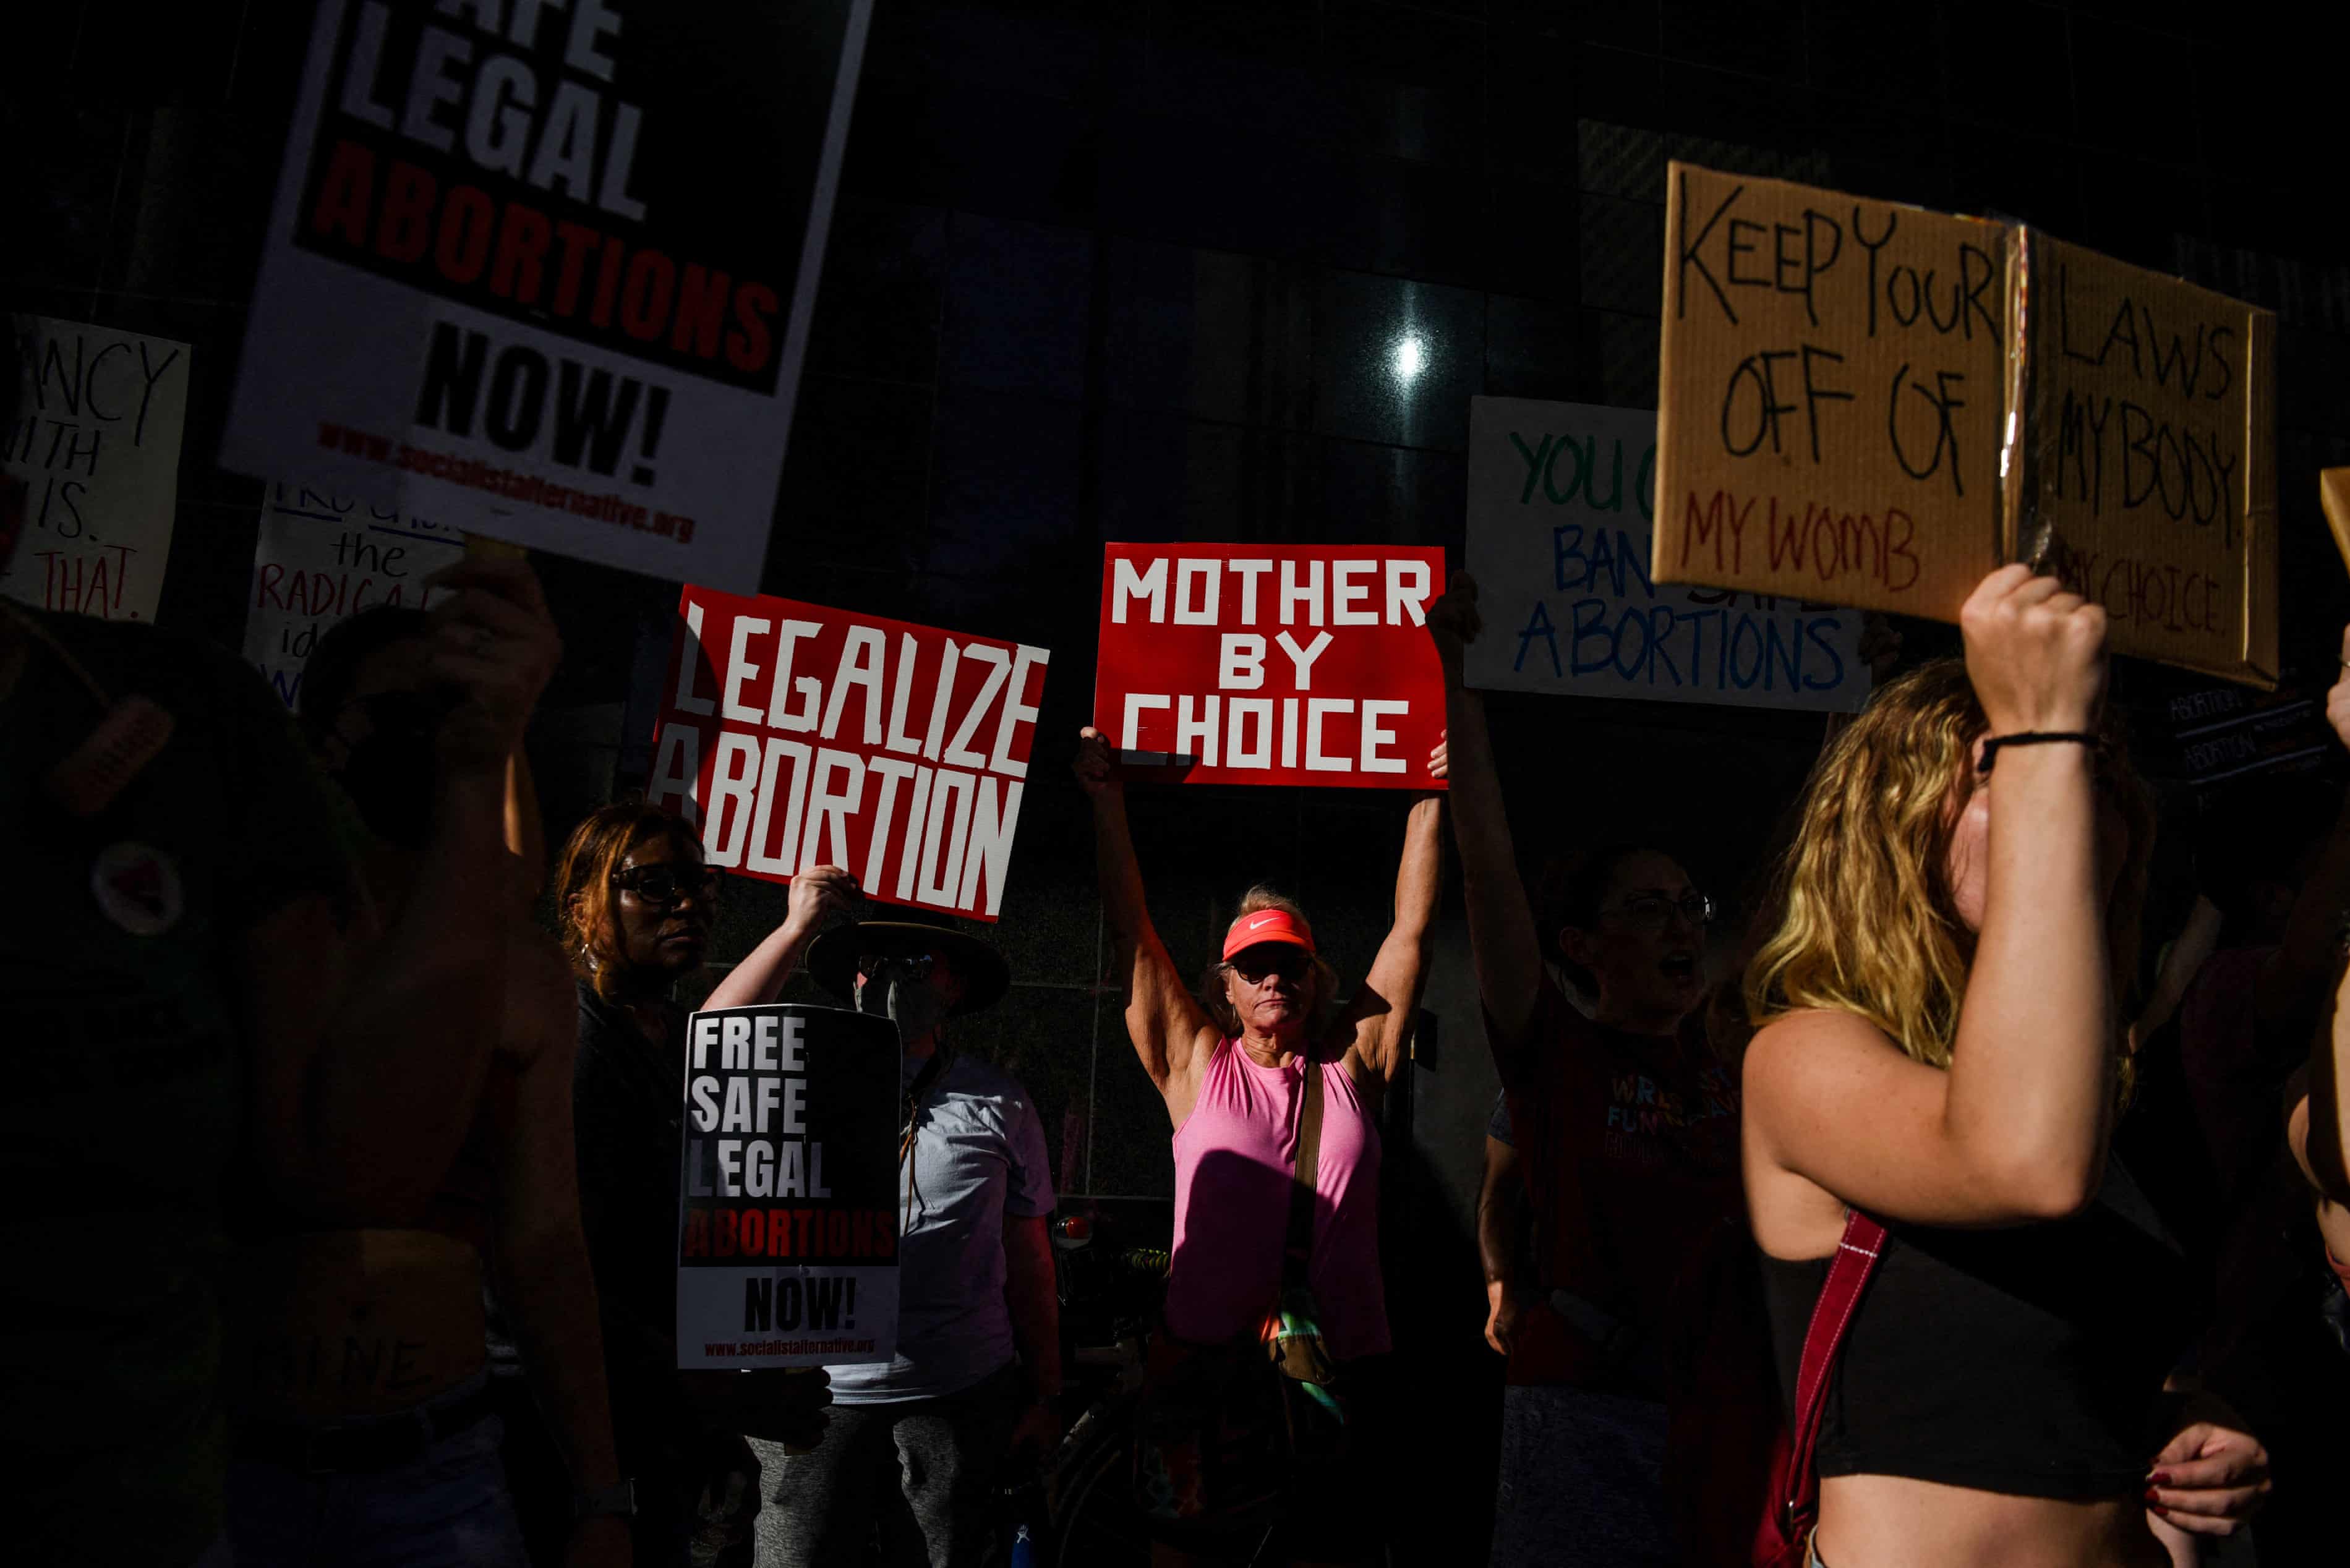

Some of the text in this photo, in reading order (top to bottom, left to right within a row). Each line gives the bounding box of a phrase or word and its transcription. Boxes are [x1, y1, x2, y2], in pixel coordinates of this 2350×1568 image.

[338, 0, 648, 224] LEGAL
[311, 138, 779, 375] ABORTIONS
[1679, 171, 2236, 401] KEEP YOUR LAWS
[416, 322, 670, 487] NOW!
[1723, 344, 1855, 464] OFF
[1890, 362, 1965, 497] OF
[2058, 388, 2110, 518] MY
[319, 422, 695, 543] www.socialistalternative.org
[1510, 432, 1622, 513] YOU
[329, 532, 408, 577] the
[1680, 492, 1756, 575] MY
[1769, 496, 1920, 592] WOMB
[1111, 557, 1431, 628] MOTHER
[1218, 629, 1335, 691] BY
[1514, 598, 1844, 693] ABORTIONS
[674, 599, 1051, 778] LEGALIZE
[1120, 692, 1410, 774] CHOICE
[647, 722, 1025, 916] ABORTION
[693, 1015, 807, 1071] FREE
[690, 1075, 807, 1135] SAFE
[688, 1138, 832, 1199] LEGAL
[683, 1206, 896, 1258] ABORTIONS
[745, 1276, 857, 1332] NOW!
[704, 1337, 876, 1357] www.socialistalternative.org
